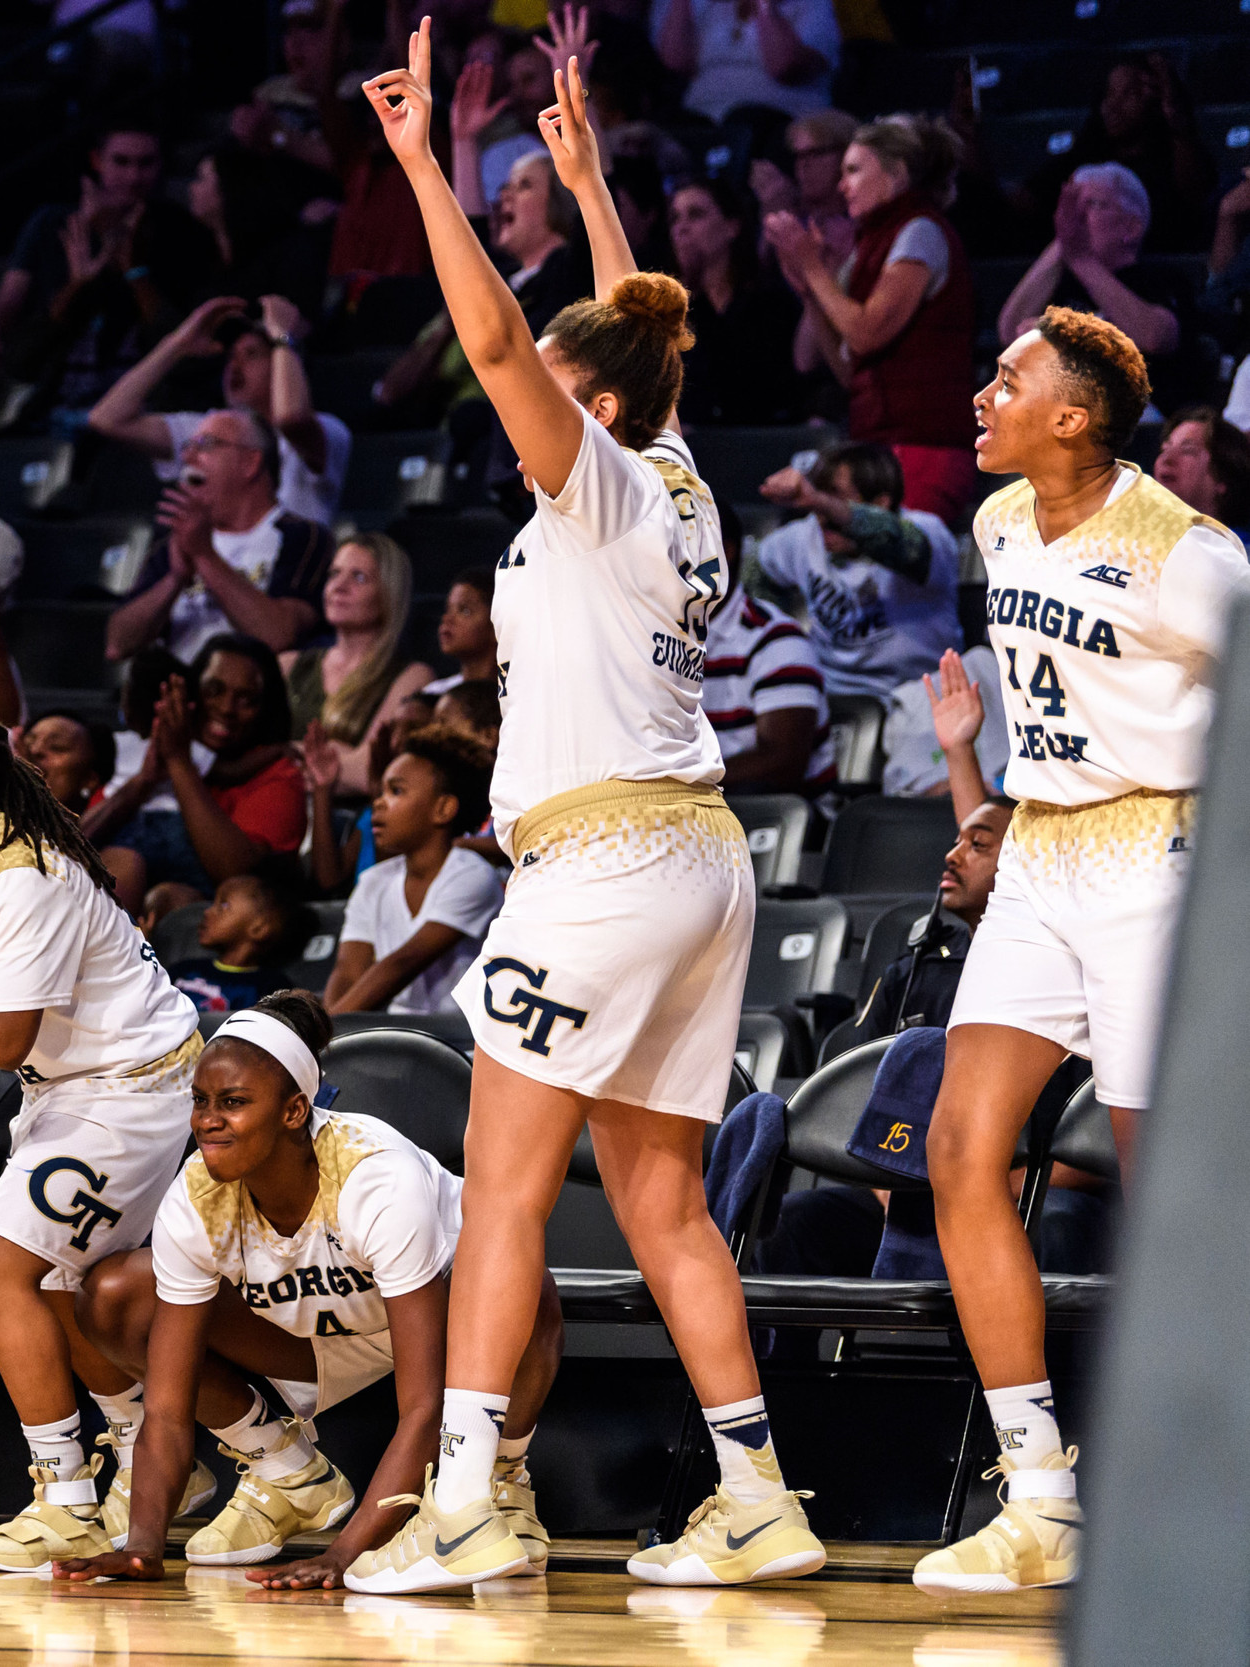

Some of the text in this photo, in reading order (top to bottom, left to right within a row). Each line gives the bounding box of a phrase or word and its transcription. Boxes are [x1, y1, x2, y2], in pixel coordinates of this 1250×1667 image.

[1079, 564, 1133, 590] ACC
[986, 587, 1122, 660] EORGIA
[482, 954, 590, 1059] GT
[877, 1122, 913, 1153] 15
[26, 1154, 125, 1254] GT
